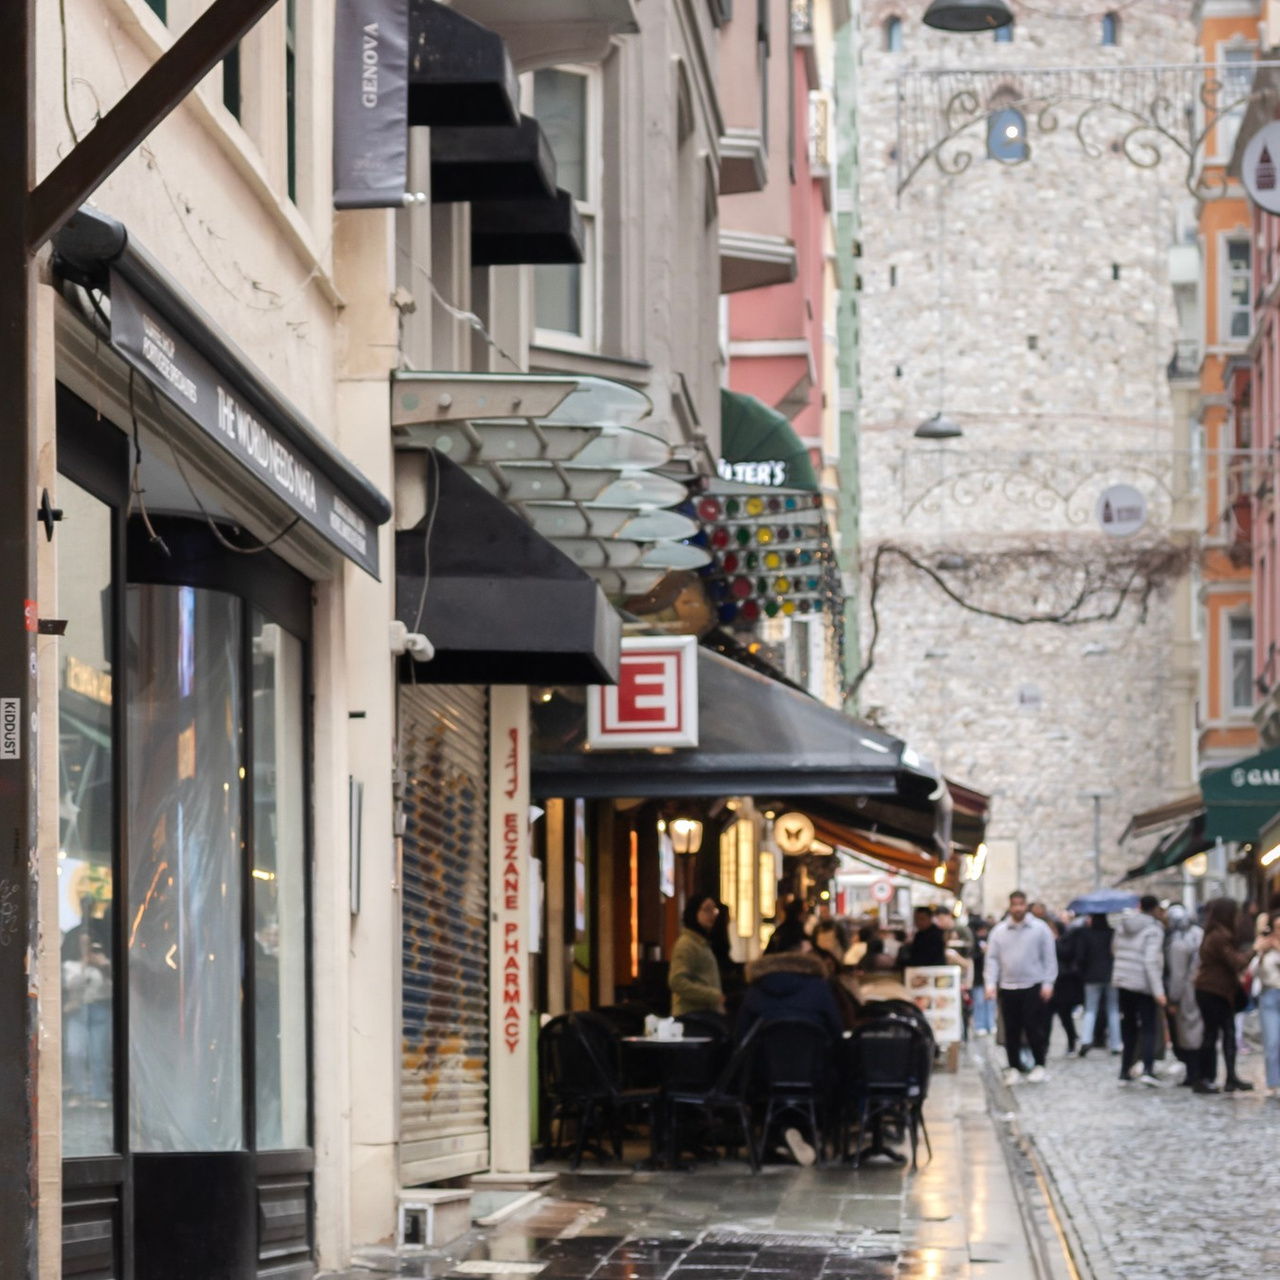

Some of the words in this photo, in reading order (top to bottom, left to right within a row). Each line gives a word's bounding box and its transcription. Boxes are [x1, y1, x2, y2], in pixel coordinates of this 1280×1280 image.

[361, 21, 380, 109] GENOVA
[217, 386, 235, 439] THE
[235, 402, 269, 468] WORLD
[269, 435, 294, 494] NEEDS
[294, 462, 317, 514] NATA
[618, 662, 666, 723] E
[504, 813, 520, 911] ECZANE
[504, 923, 520, 1055] PHARMACY
